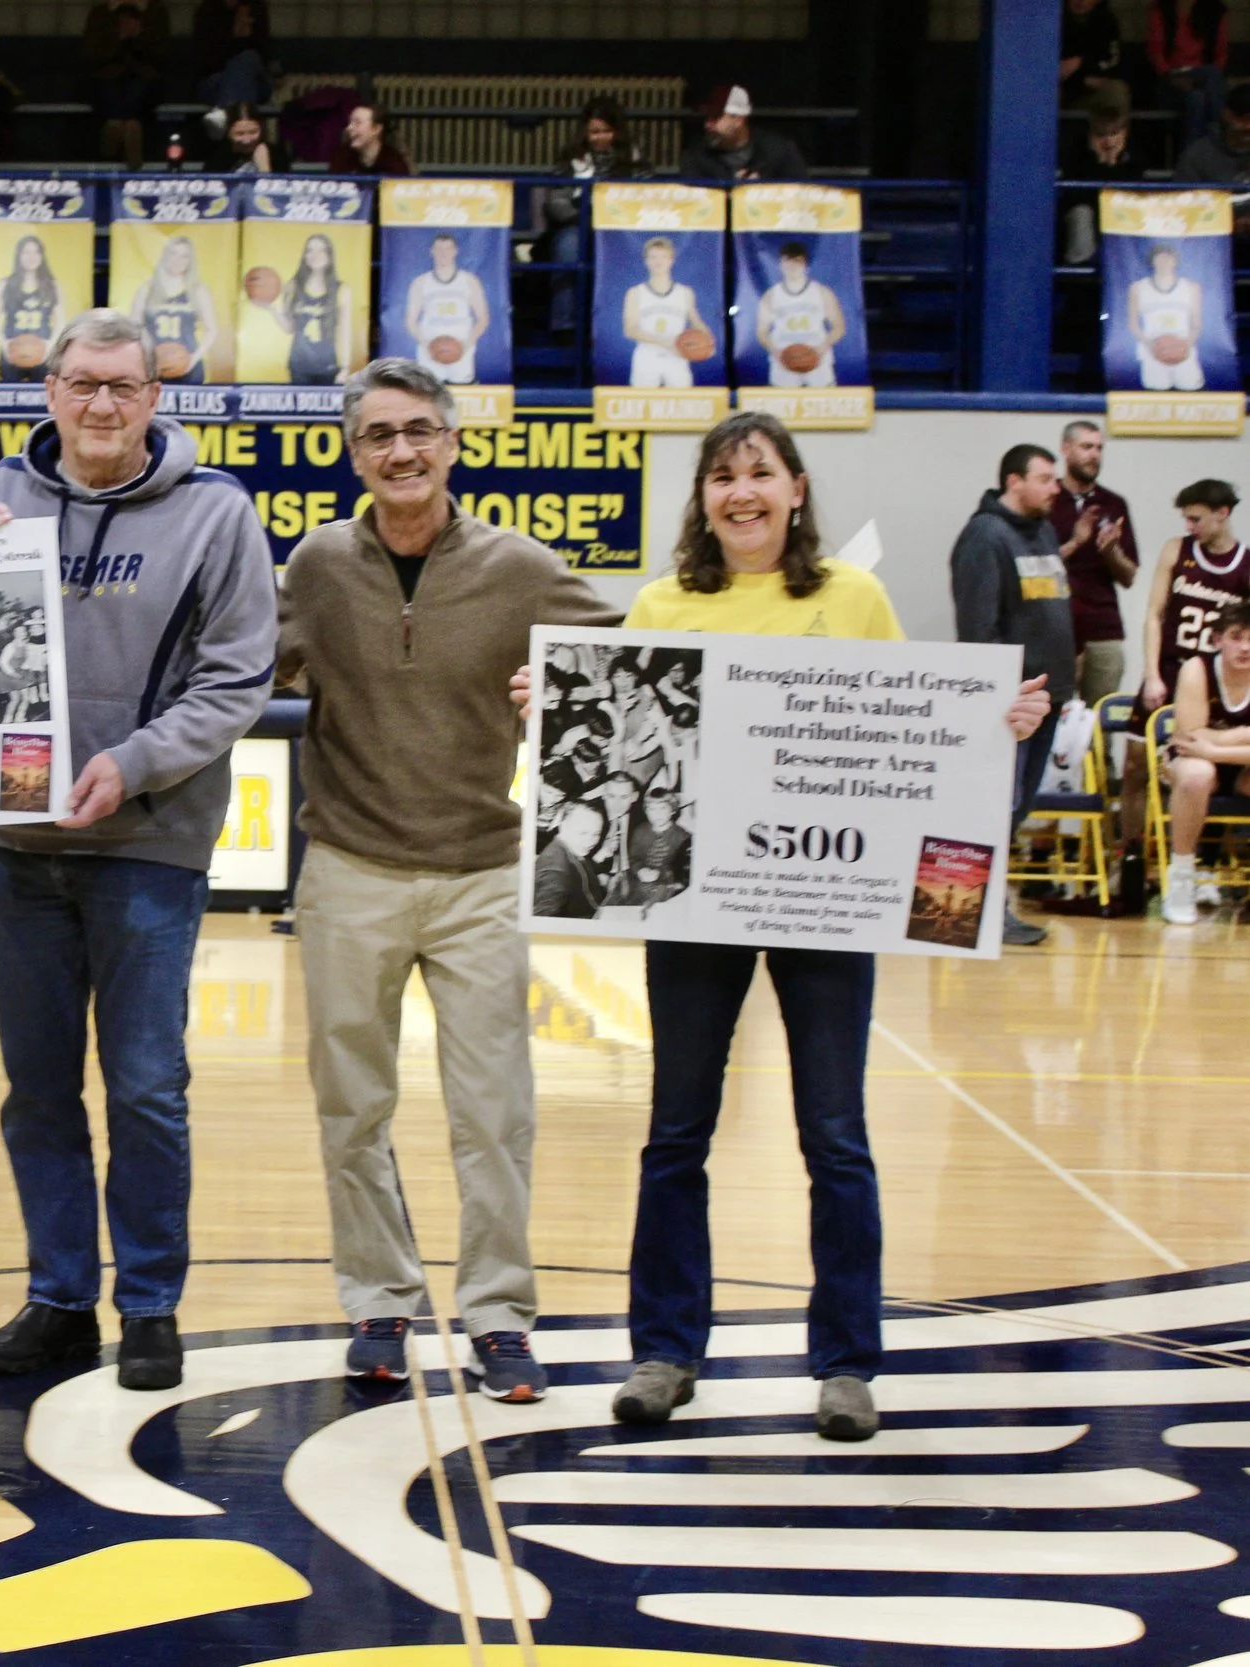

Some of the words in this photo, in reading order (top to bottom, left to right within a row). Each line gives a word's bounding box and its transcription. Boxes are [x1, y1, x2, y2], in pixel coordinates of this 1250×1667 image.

[272, 424, 343, 467] TO
[461, 423, 641, 469] SEMER
[727, 664, 863, 692] Recognizing
[866, 669, 914, 690] Carl
[919, 671, 997, 697] Gregas
[784, 692, 820, 712] for
[823, 695, 854, 714] his
[860, 697, 933, 718] valued
[748, 722, 899, 744] contributions
[903, 728, 926, 745] to
[929, 727, 967, 747] the
[774, 748, 881, 770] Bessemer
[885, 753, 937, 773] Area
[773, 775, 846, 796] School
[850, 779, 934, 800] District
[745, 821, 865, 863] $500
[707, 866, 761, 881] donation
